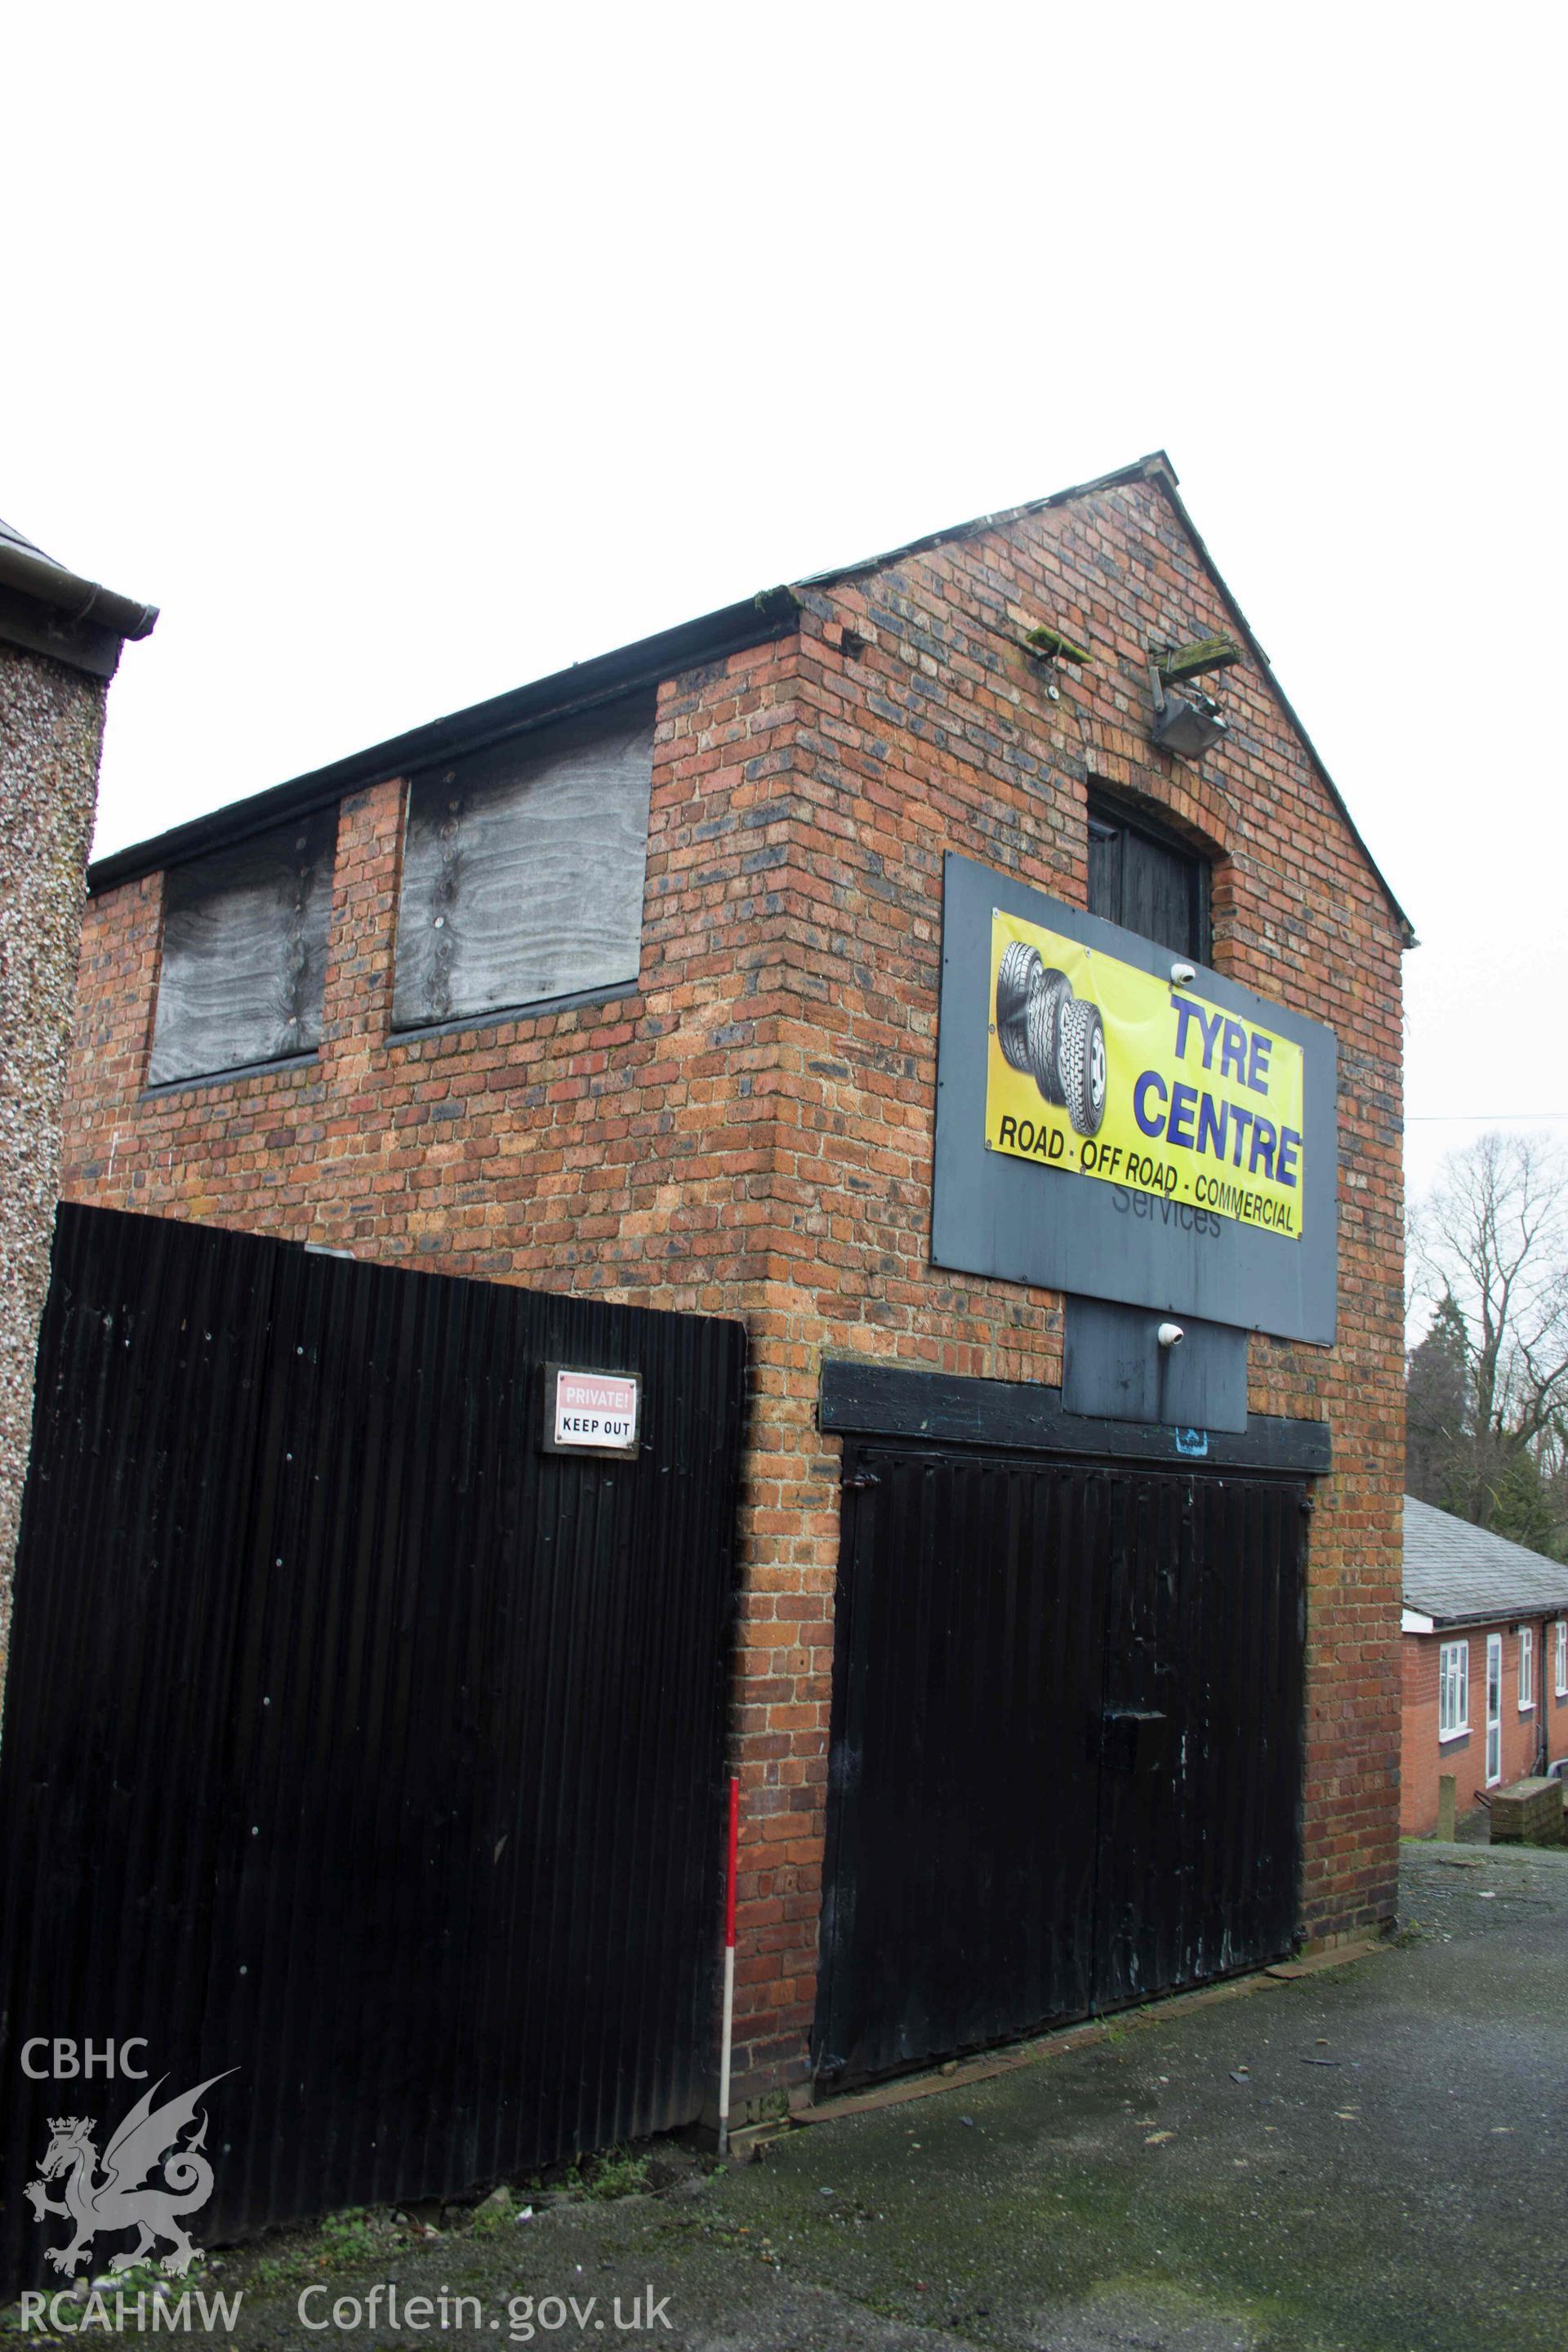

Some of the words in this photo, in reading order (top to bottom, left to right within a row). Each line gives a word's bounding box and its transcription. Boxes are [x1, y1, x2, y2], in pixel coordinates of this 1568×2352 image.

[1170, 993, 1272, 1096] TYRE
[999, 1115, 1064, 1159] ROAD
[1080, 1140, 1123, 1175] OFF
[1125, 1152, 1178, 1192] ROAD
[1195, 1174, 1293, 1232] COMMERCIAL
[1134, 1071, 1300, 1187] CENTRE
[564, 1417, 599, 1432] KEEP
[604, 1421, 630, 1436] OUT
[566, 1387, 628, 1409] PRIVATE!
